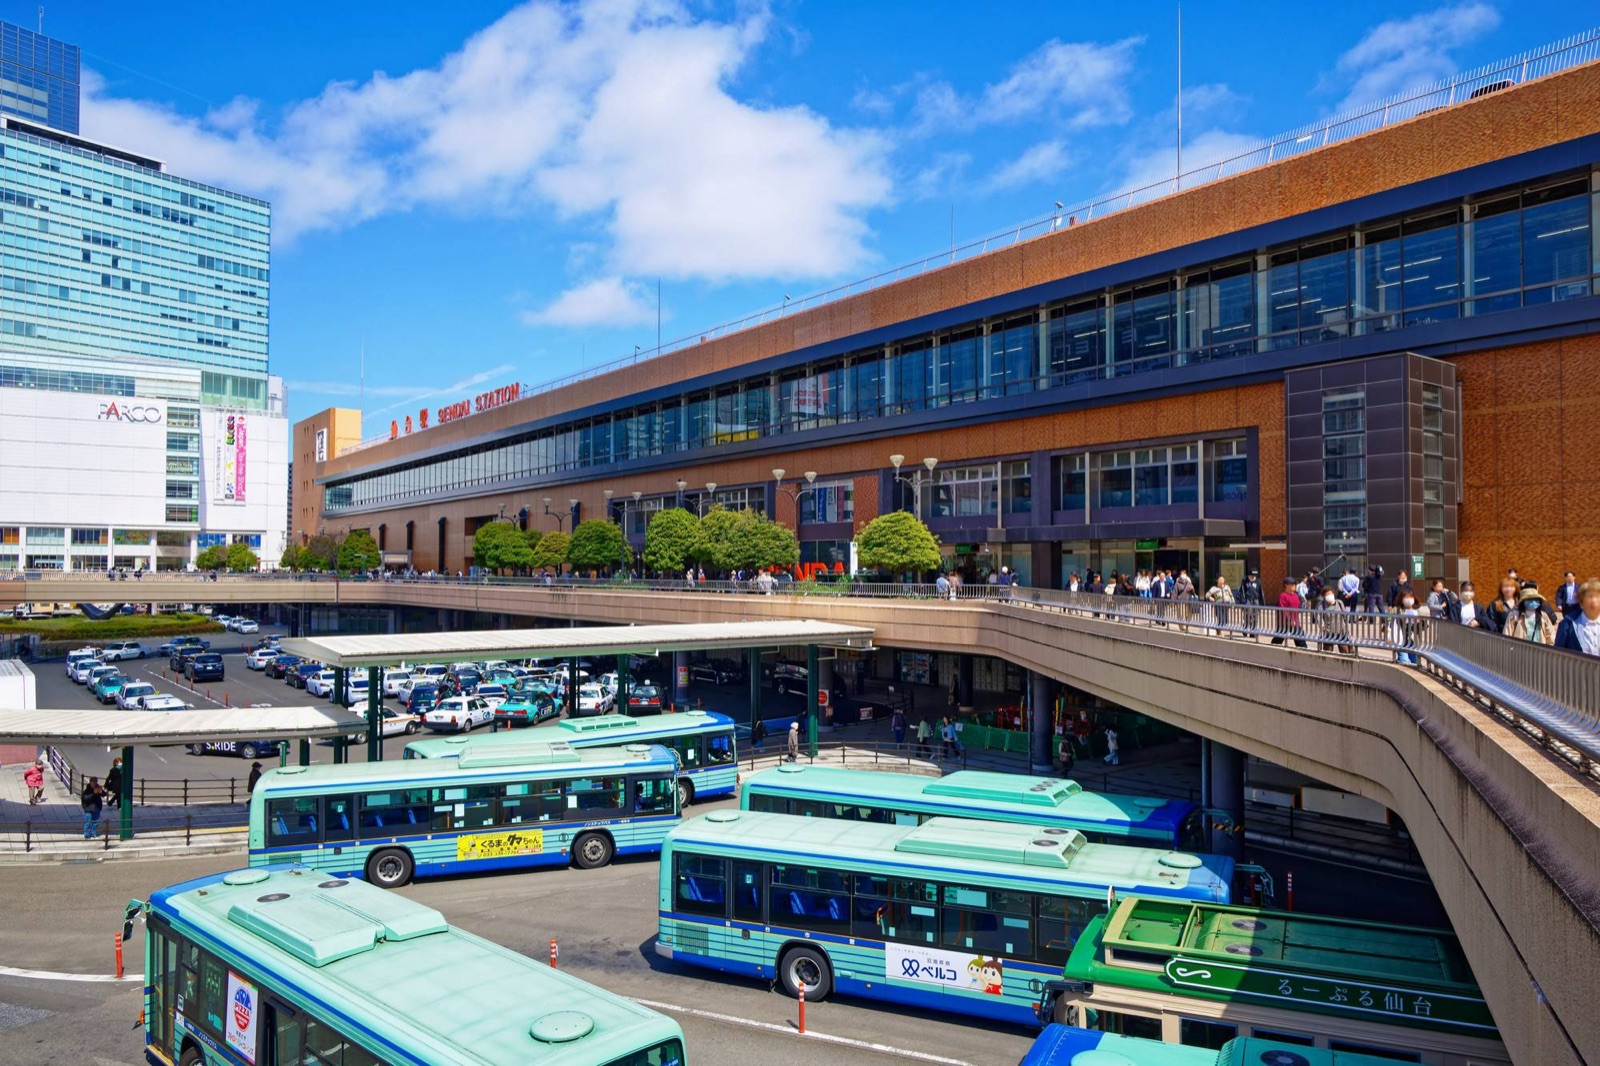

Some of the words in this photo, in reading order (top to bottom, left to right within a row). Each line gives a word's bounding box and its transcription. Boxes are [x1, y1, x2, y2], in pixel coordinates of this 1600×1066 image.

[438, 399, 470, 423] SENDAI
[475, 382, 520, 412] STATION
[98, 402, 161, 423] PARCO
[206, 741, 236, 751] S.RIDE
[921, 966, 957, 981] ベルコ
[1278, 979, 1431, 1015] るーぷる仙台
[234, 1002, 250, 1017] PIZZA
